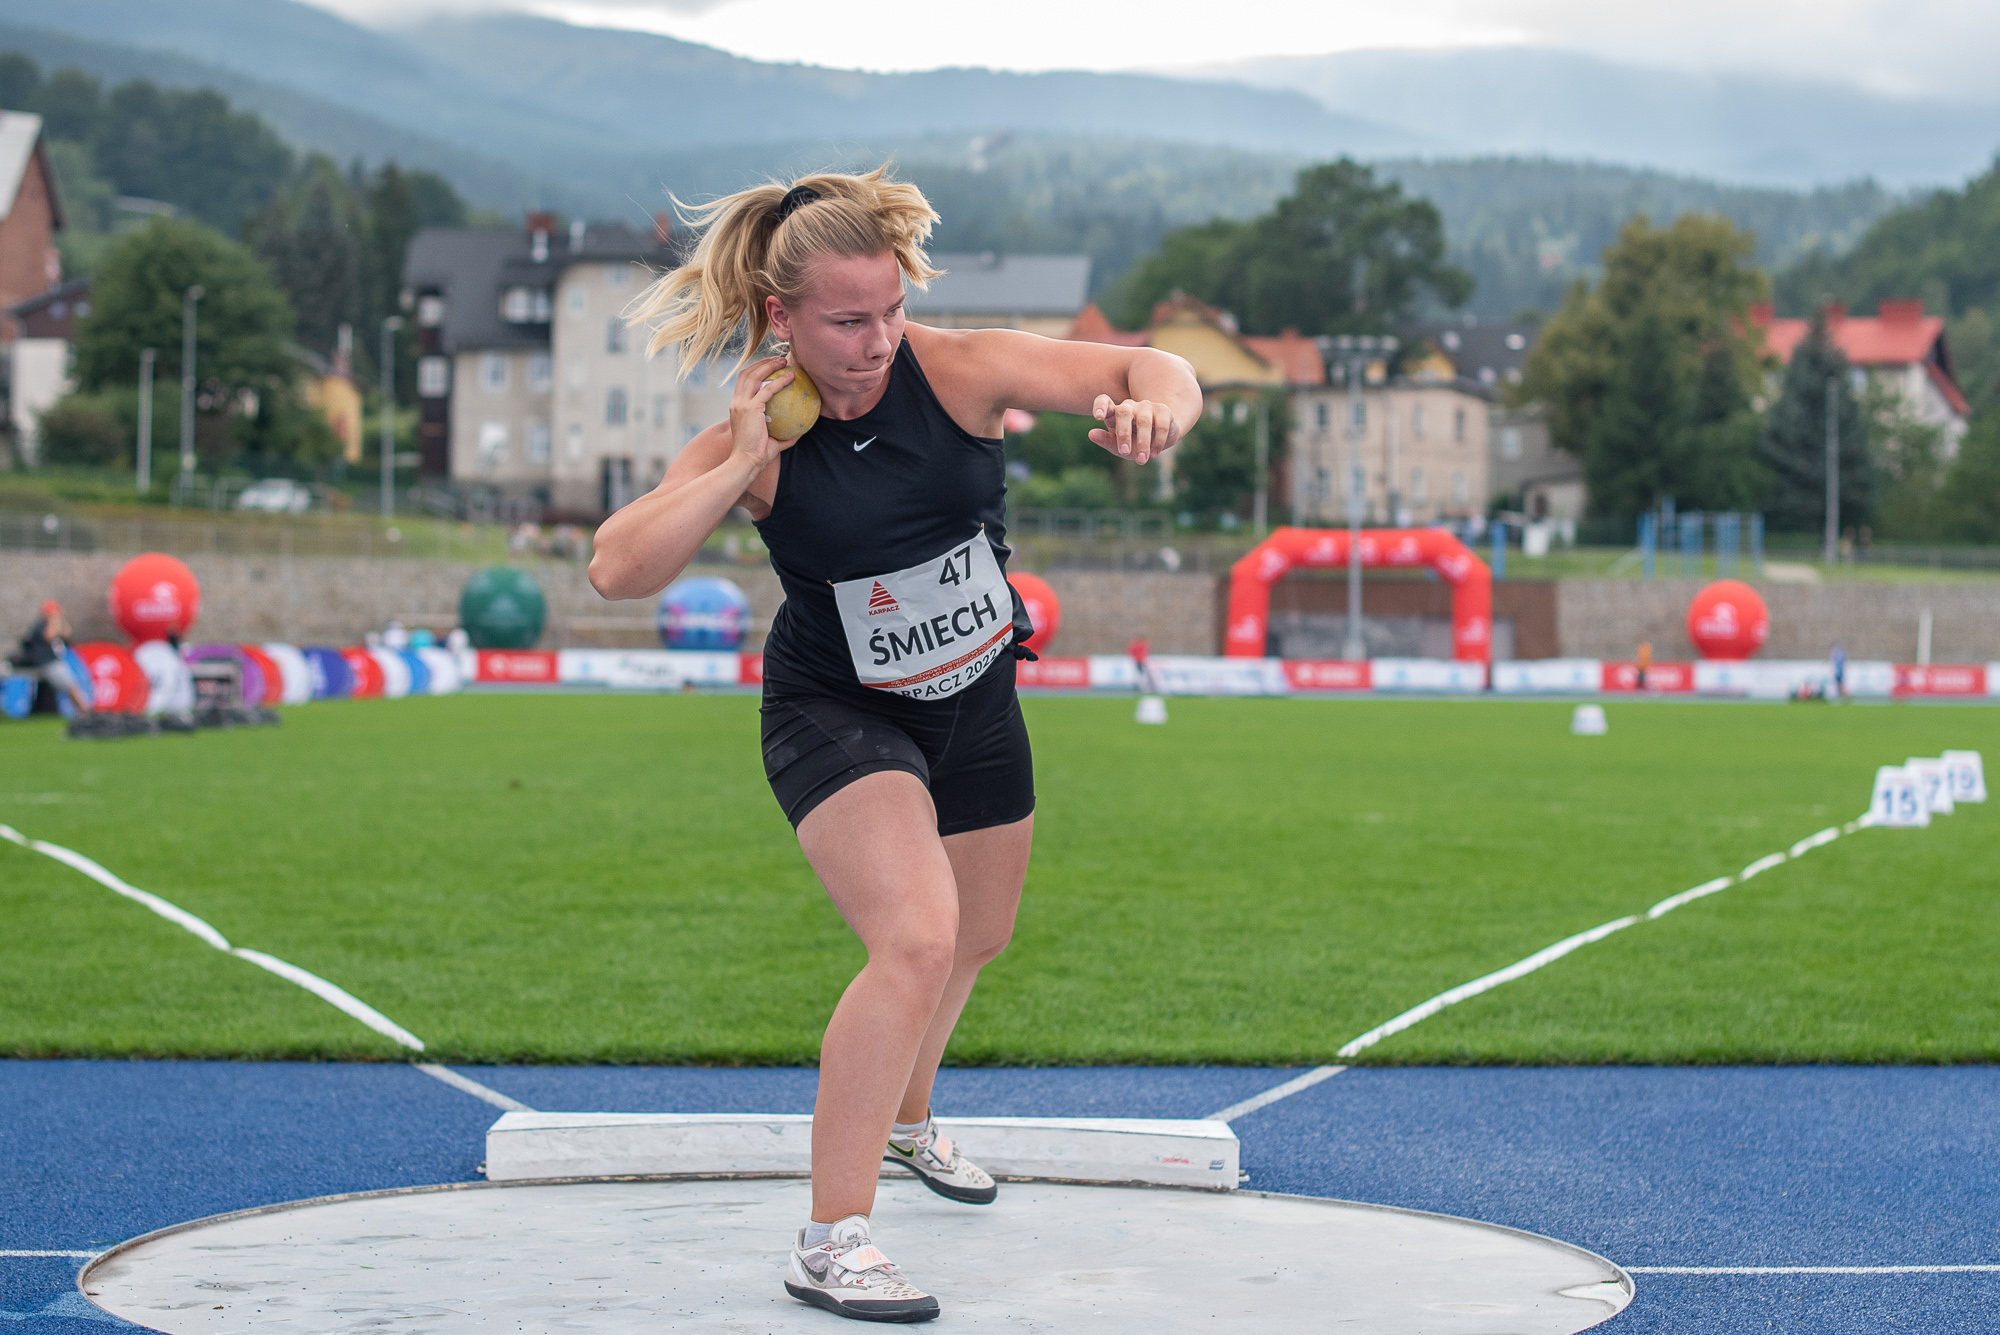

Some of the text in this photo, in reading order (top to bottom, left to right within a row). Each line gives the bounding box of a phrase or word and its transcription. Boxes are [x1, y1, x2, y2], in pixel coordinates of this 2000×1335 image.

[939, 545, 971, 586] 47
[868, 605, 900, 616] KARPACZ
[869, 592, 997, 666] ŚMIECH
[891, 648, 997, 698] RPACZ 2022
[1882, 787, 1918, 819] 15
